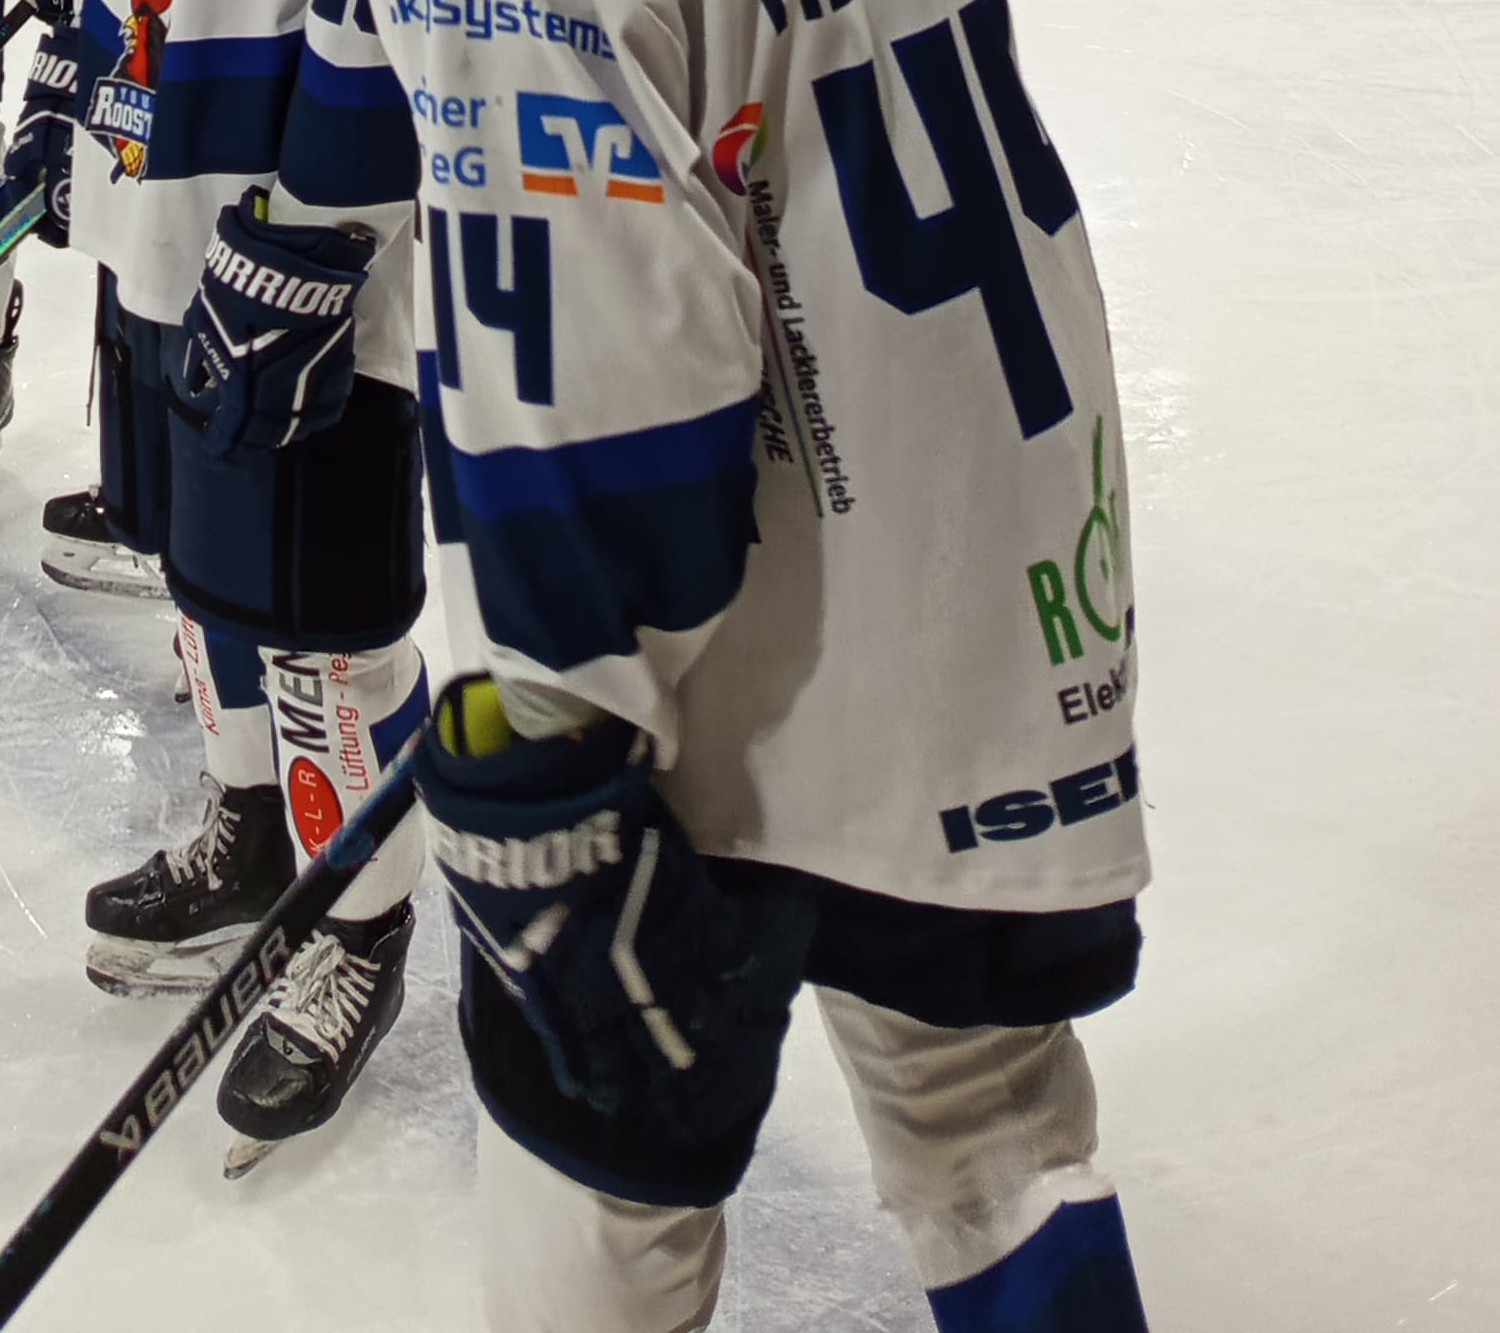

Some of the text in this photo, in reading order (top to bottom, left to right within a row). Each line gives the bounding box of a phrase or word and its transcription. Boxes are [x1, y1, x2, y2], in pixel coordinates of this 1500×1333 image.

[430, 145, 487, 187] eG
[768, 258, 804, 314] und
[780, 315, 858, 517] Lackiererbetrieb
[334, 704, 372, 793] Lüftung
